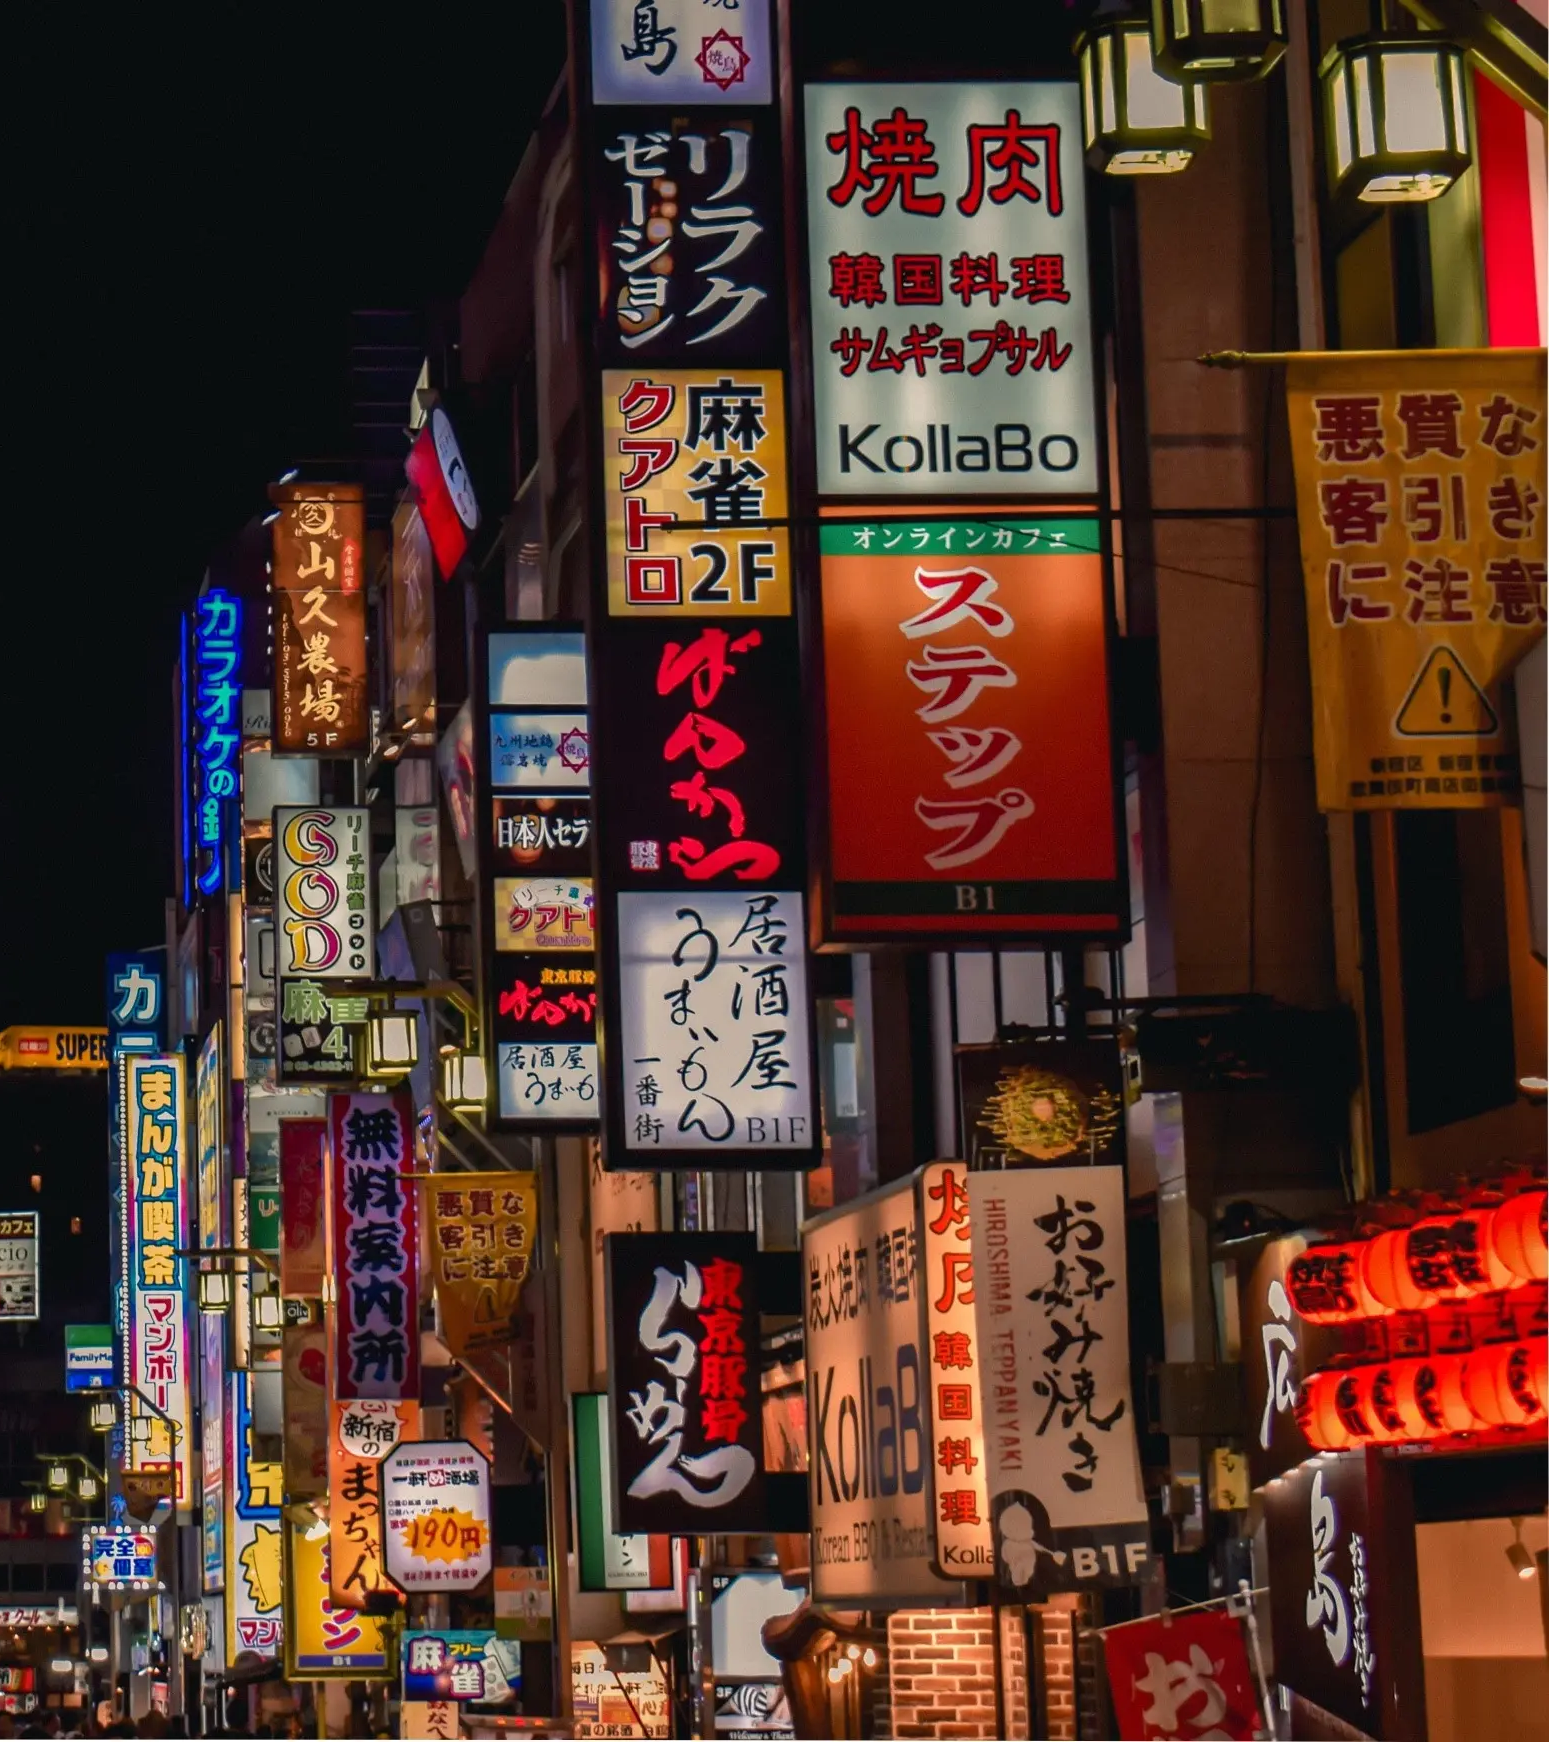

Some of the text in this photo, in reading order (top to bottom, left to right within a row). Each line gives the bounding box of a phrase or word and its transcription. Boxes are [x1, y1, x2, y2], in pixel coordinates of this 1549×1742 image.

[825, 106, 1064, 218] 焼肉
[604, 132, 675, 349] ゼーション
[678, 130, 768, 346] リラク
[829, 252, 1071, 308] 韓国料理
[830, 320, 1073, 377] サムギョプサル
[682, 377, 769, 531] 麻雀
[837, 423, 1080, 474] KollaBo
[1313, 392, 1539, 462] 悪質な
[618, 379, 682, 606] クアトロ
[1317, 474, 1540, 546] 客引き
[688, 541, 776, 604] 2F
[852, 525, 1069, 550] オンラインカフェ
[1327, 555, 1549, 627] に注意
[297, 541, 342, 724] 山久農場
[306, 732, 339, 747] 5F
[898, 565, 1036, 871] ステップ
[346, 814, 366, 910] リーチ麻雀
[508, 903, 595, 933] クアト
[954, 885, 996, 911] B1
[663, 907, 736, 1143] うまいもん
[729, 894, 797, 1091] 居酒屋
[502, 1044, 587, 1070] 居酒屋
[633, 1055, 665, 1145] 一番街
[746, 1116, 806, 1144] B1F
[139, 1069, 177, 1286] まんが喫茶
[436, 1190, 525, 1218] 悪質な
[346, 1107, 408, 1384] 無料案内所
[438, 1223, 527, 1253] 客引き
[440, 1253, 529, 1283] に注意
[982, 1198, 1010, 1320] HIROSHIMA
[809, 1243, 869, 1331] 炭火焼肉
[144, 1293, 175, 1412] マンボー
[698, 1256, 747, 1443] 東京豚骨
[1025, 1194, 1124, 1493] お好み焼き
[342, 1413, 399, 1442] 新宿
[361, 1439, 381, 1456] の
[811, 1343, 924, 1507] KollaB
[932, 1330, 982, 1526] 韓国料理
[94, 1537, 135, 1558] 完全
[410, 1517, 482, 1551] 190円
[814, 1525, 850, 1565] Korean
[852, 1521, 877, 1561] BBQ
[1071, 1541, 1149, 1579] B1F
[712, 1577, 730, 1589] 5F
[449, 1643, 485, 1655] フリー
[715, 1686, 733, 1699] 3F
